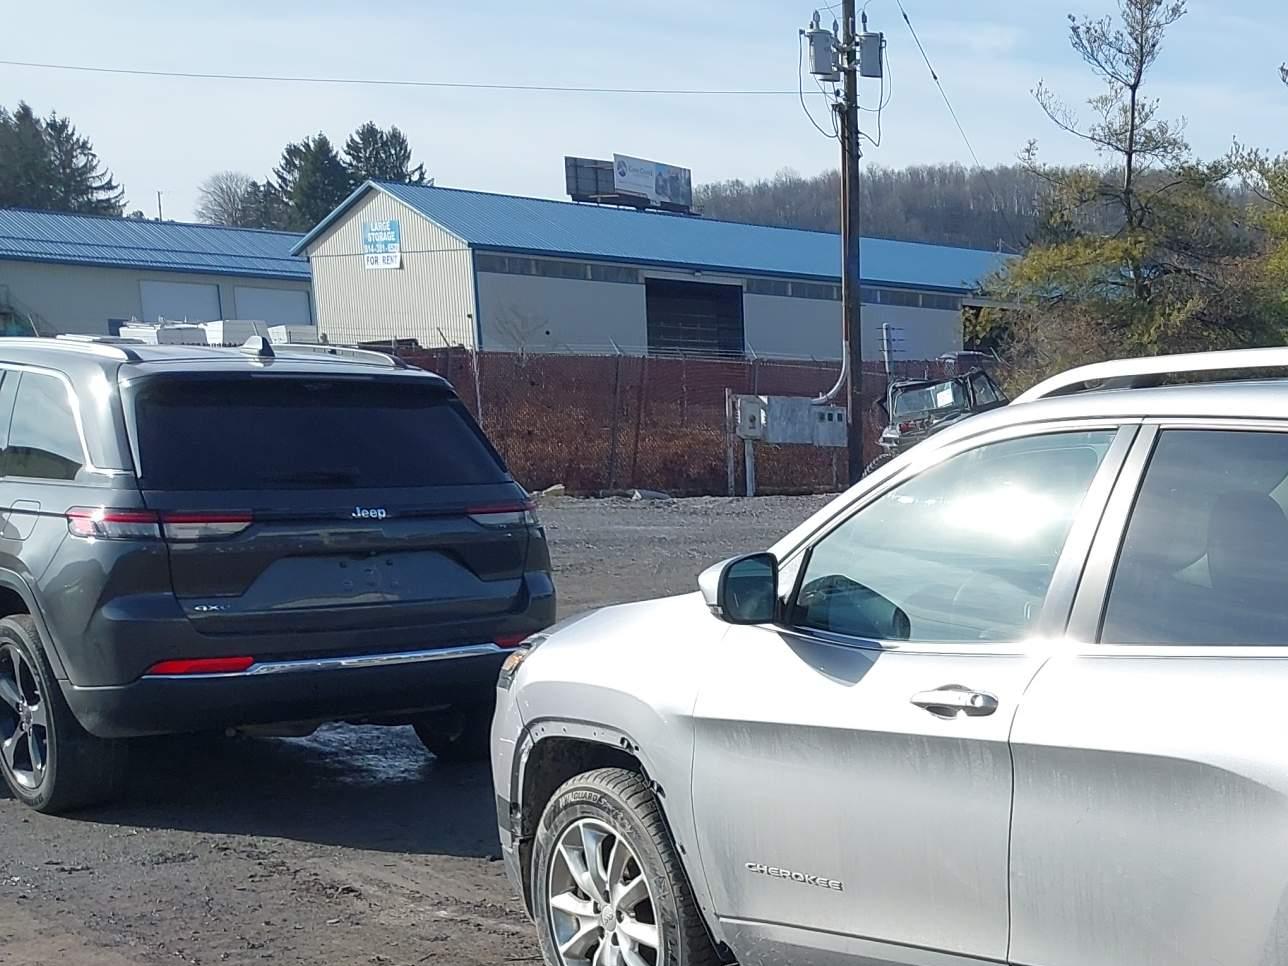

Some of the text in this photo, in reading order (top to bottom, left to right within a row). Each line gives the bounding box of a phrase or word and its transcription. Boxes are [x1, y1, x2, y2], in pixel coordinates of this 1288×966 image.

[370, 221, 391, 231] LARGE
[367, 231, 396, 242] STORAGE
[366, 255, 398, 265] FOR RENT
[351, 506, 386, 520] Jeep
[745, 862, 844, 891] CHEROKEE
